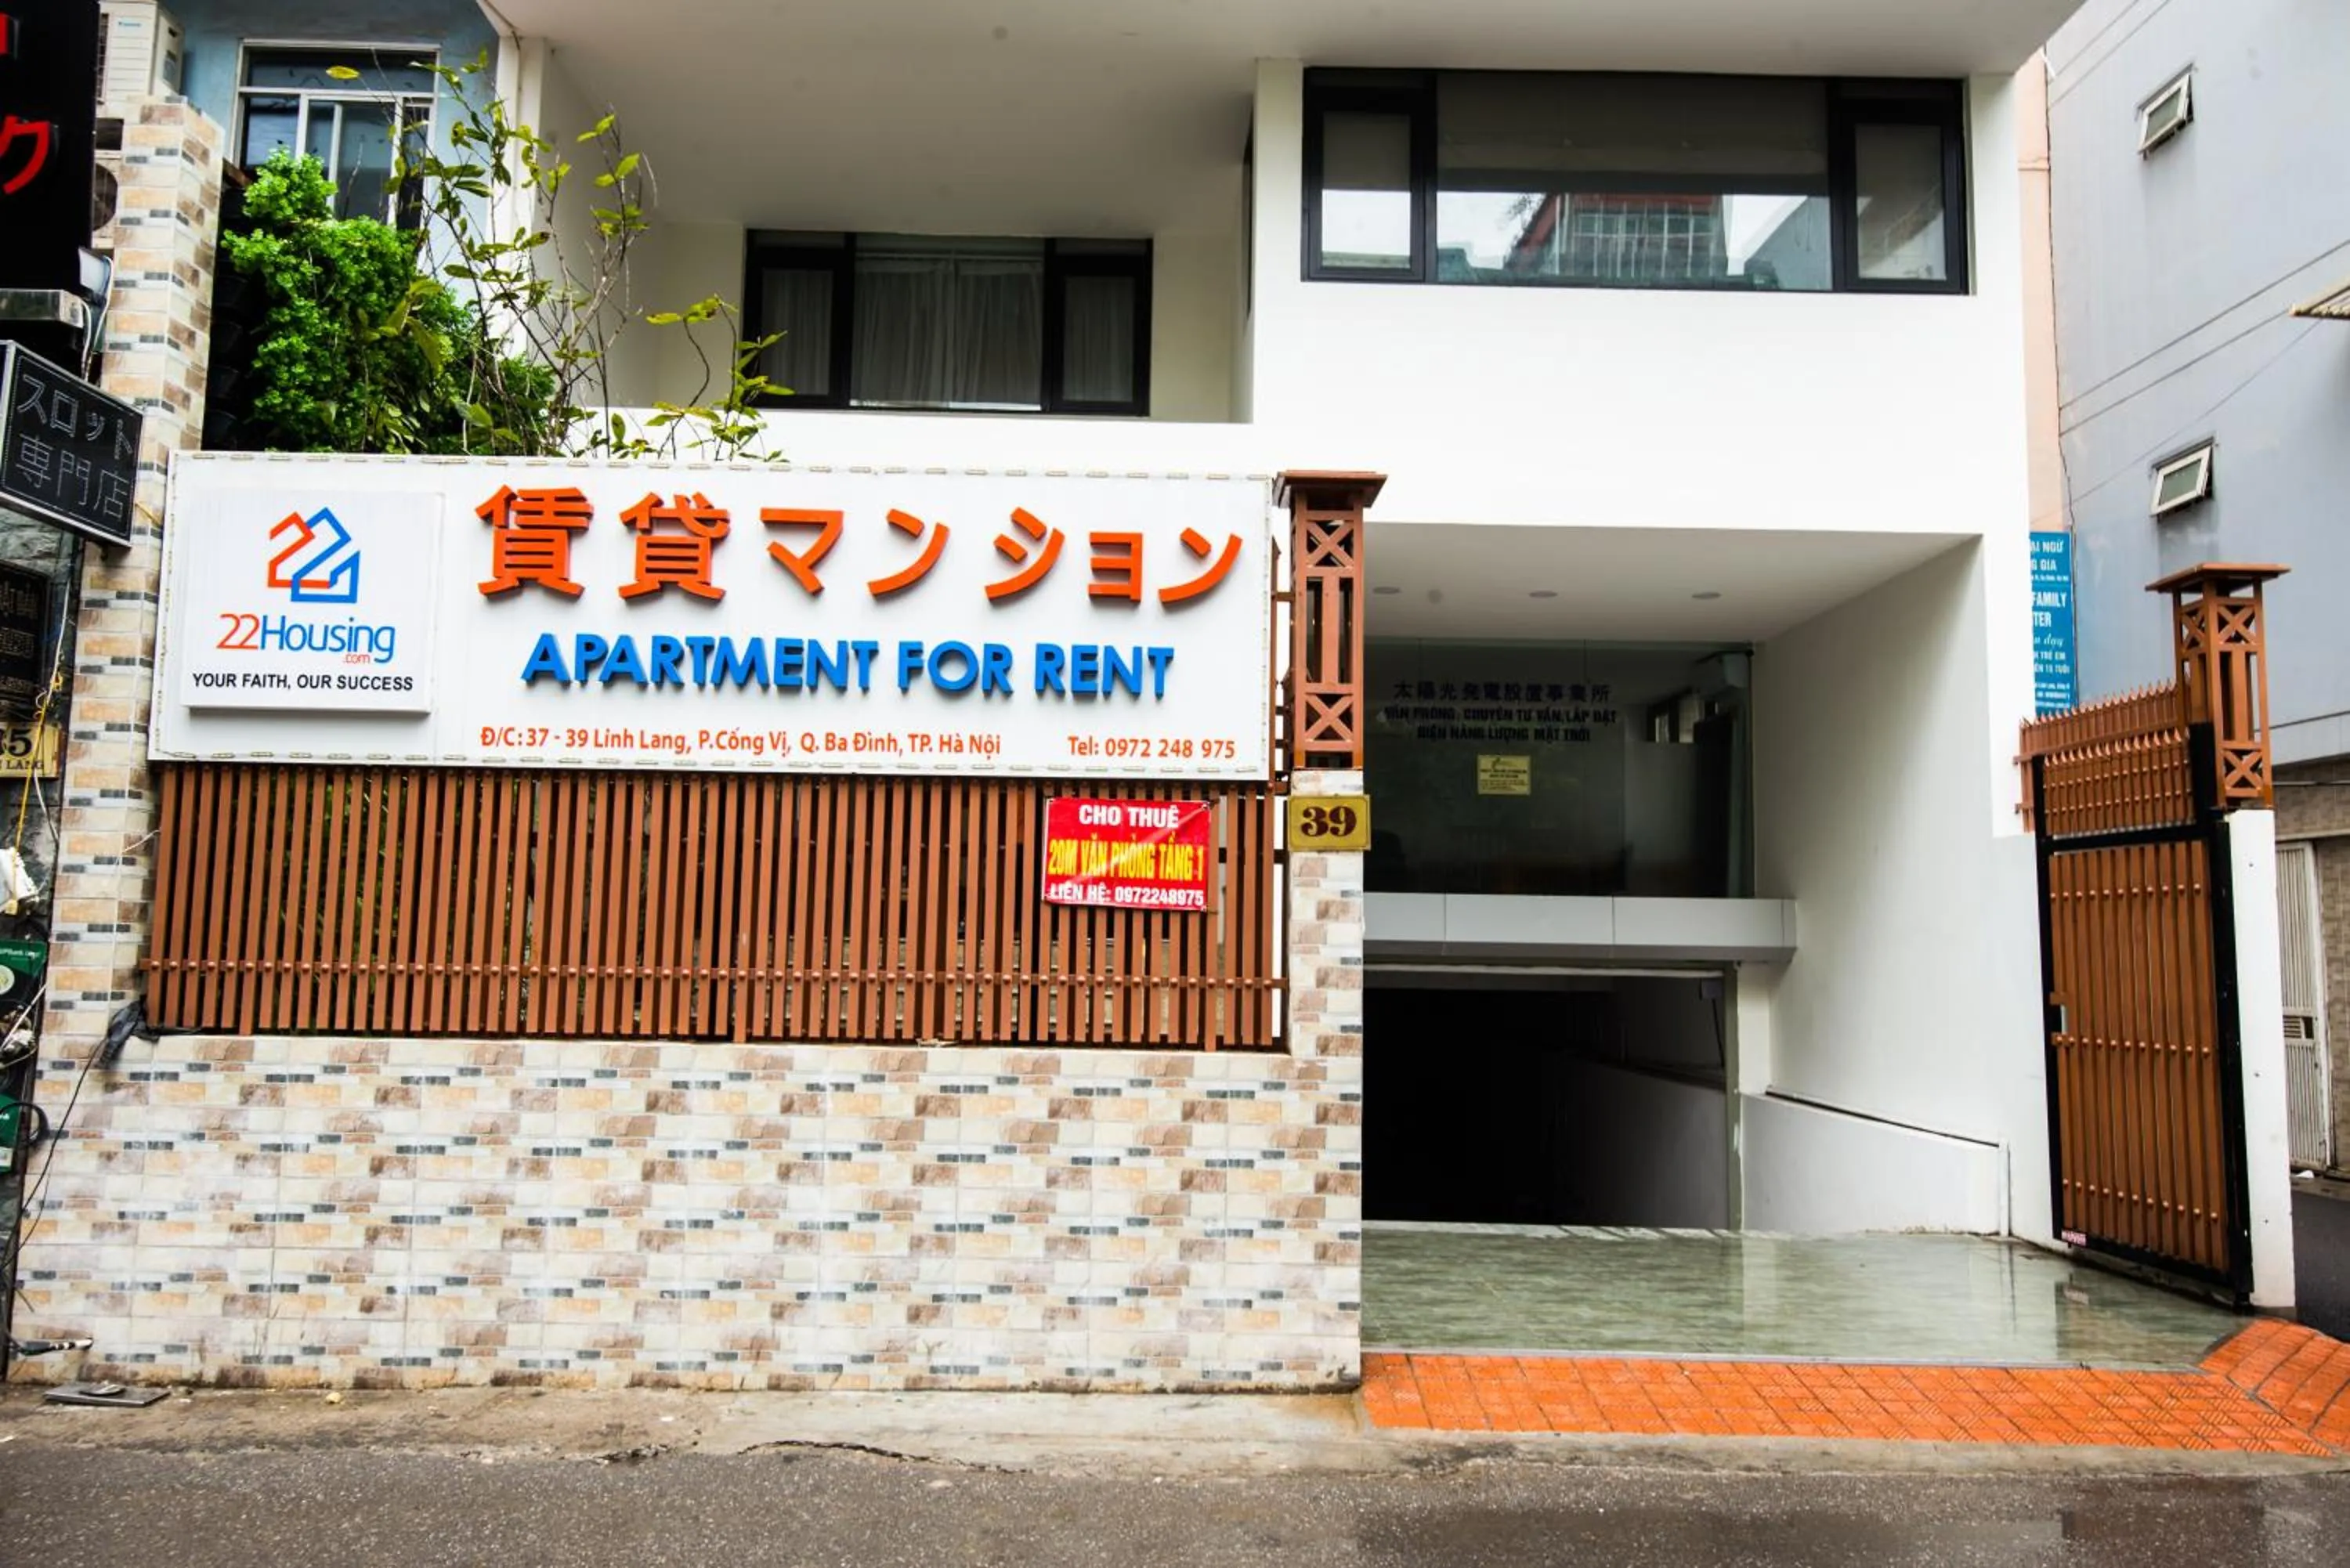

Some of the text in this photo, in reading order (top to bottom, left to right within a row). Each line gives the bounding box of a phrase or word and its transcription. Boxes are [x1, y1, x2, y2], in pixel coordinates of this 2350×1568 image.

[17, 374, 134, 460] スロット
[16, 432, 130, 518] 専門店
[475, 484, 1242, 604] 賃貸マンション
[2032, 591, 2066, 608] FAMILY
[216, 613, 396, 664] 22Housing
[521, 632, 1175, 697] APARTMENT FOR RENT
[193, 673, 413, 691] YOUR FAITH, OUR SUCCESS
[566, 728, 589, 748] 39
[594, 728, 634, 749] Linh
[639, 731, 692, 754] Lang,
[768, 731, 791, 757] Vị,
[800, 732, 819, 753] Q.
[824, 732, 848, 753] Ba
[852, 732, 903, 757] Đình,
[908, 733, 933, 753] TP.
[938, 734, 964, 753] Hà
[968, 733, 1001, 761] Nội
[1067, 735, 1236, 760] Tel: 0972 248 975
[1078, 804, 1180, 829] CHO THUÊ
[1301, 805, 1358, 837] 39
[1080, 833, 1108, 877] VĂN
[1196, 844, 1205, 881] 1
[1050, 882, 1083, 901] LIÊN
[1115, 886, 1205, 906] 0972248975
